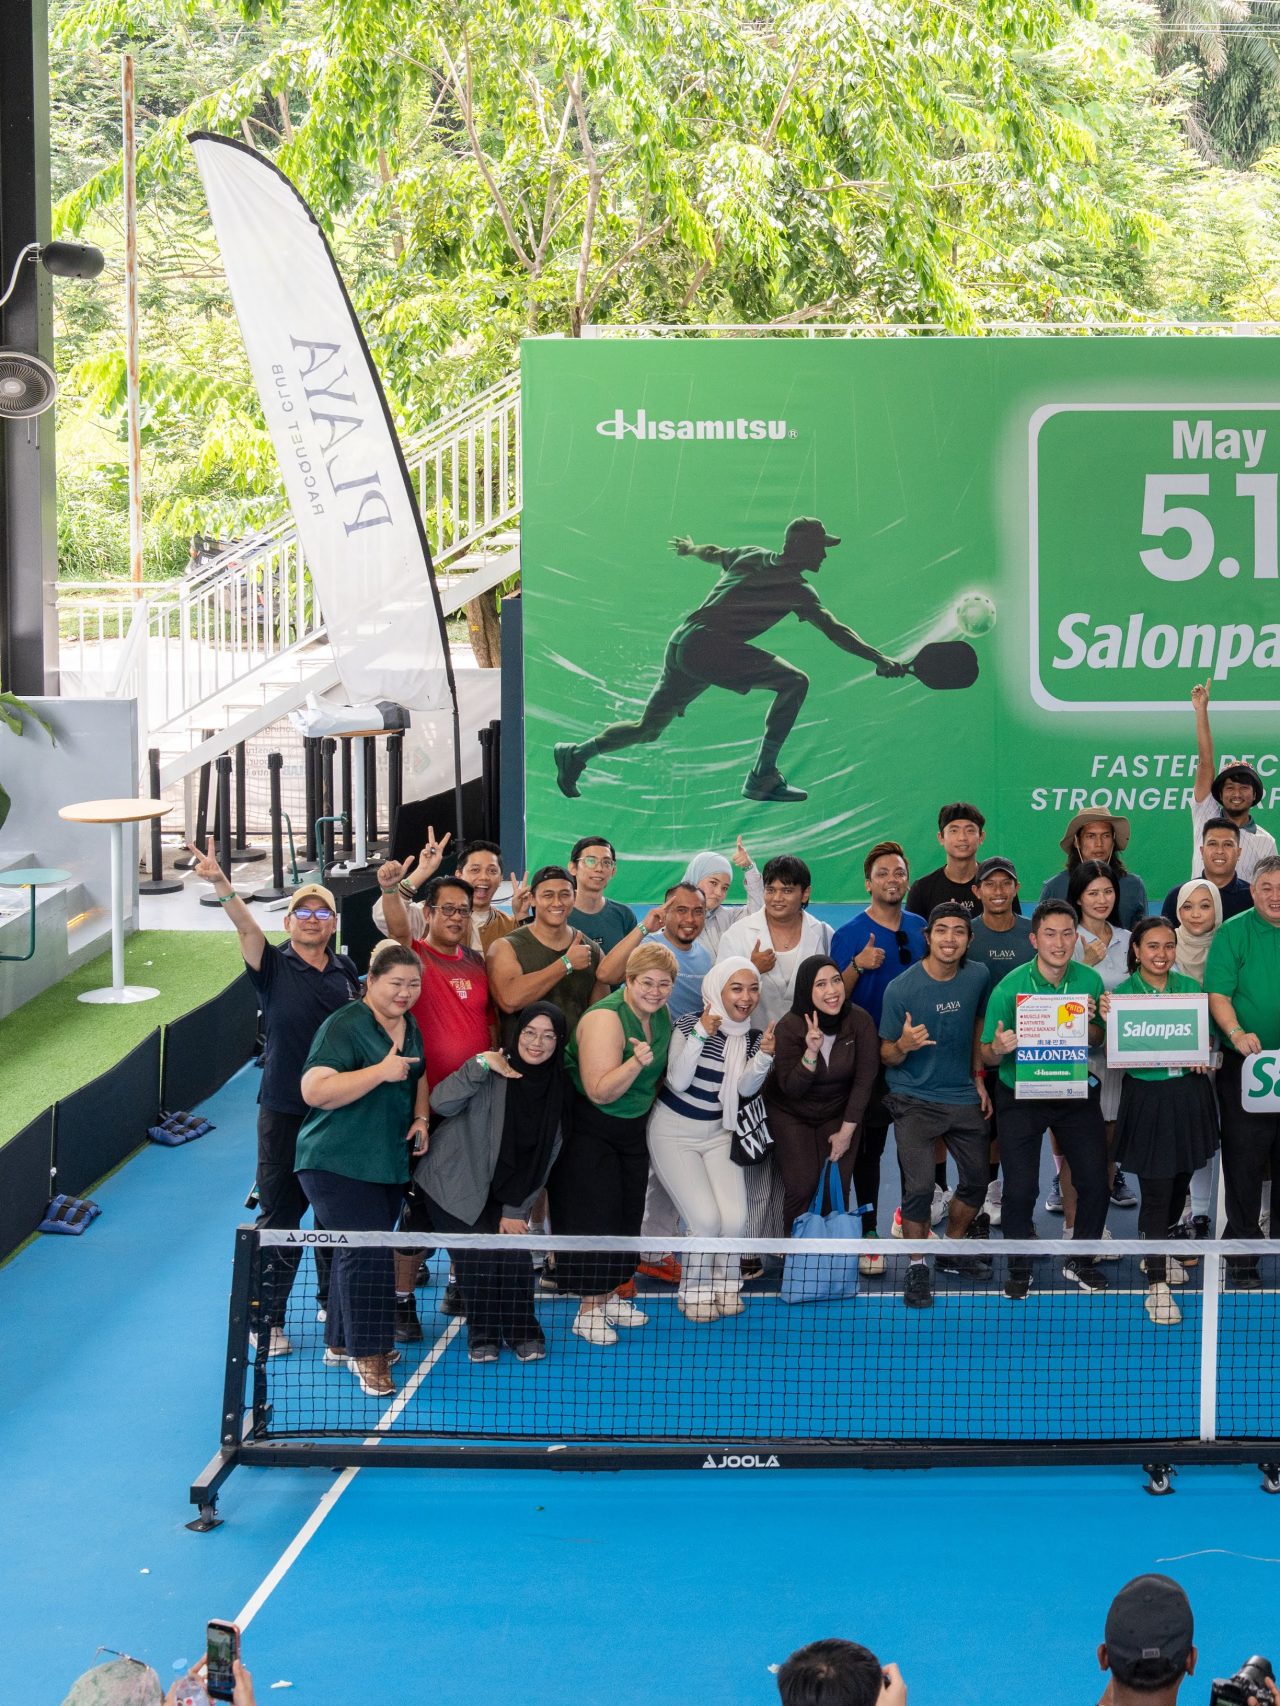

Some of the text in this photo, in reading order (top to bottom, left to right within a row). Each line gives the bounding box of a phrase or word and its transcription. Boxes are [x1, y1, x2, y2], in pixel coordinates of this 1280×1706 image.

[1173, 420, 1266, 468] May
[936, 1001, 961, 1011] PLAYA
[1123, 1021, 1192, 1039] Salonpas
[299, 1233, 349, 1243] JOOLA
[718, 1455, 780, 1468] JOOLA
